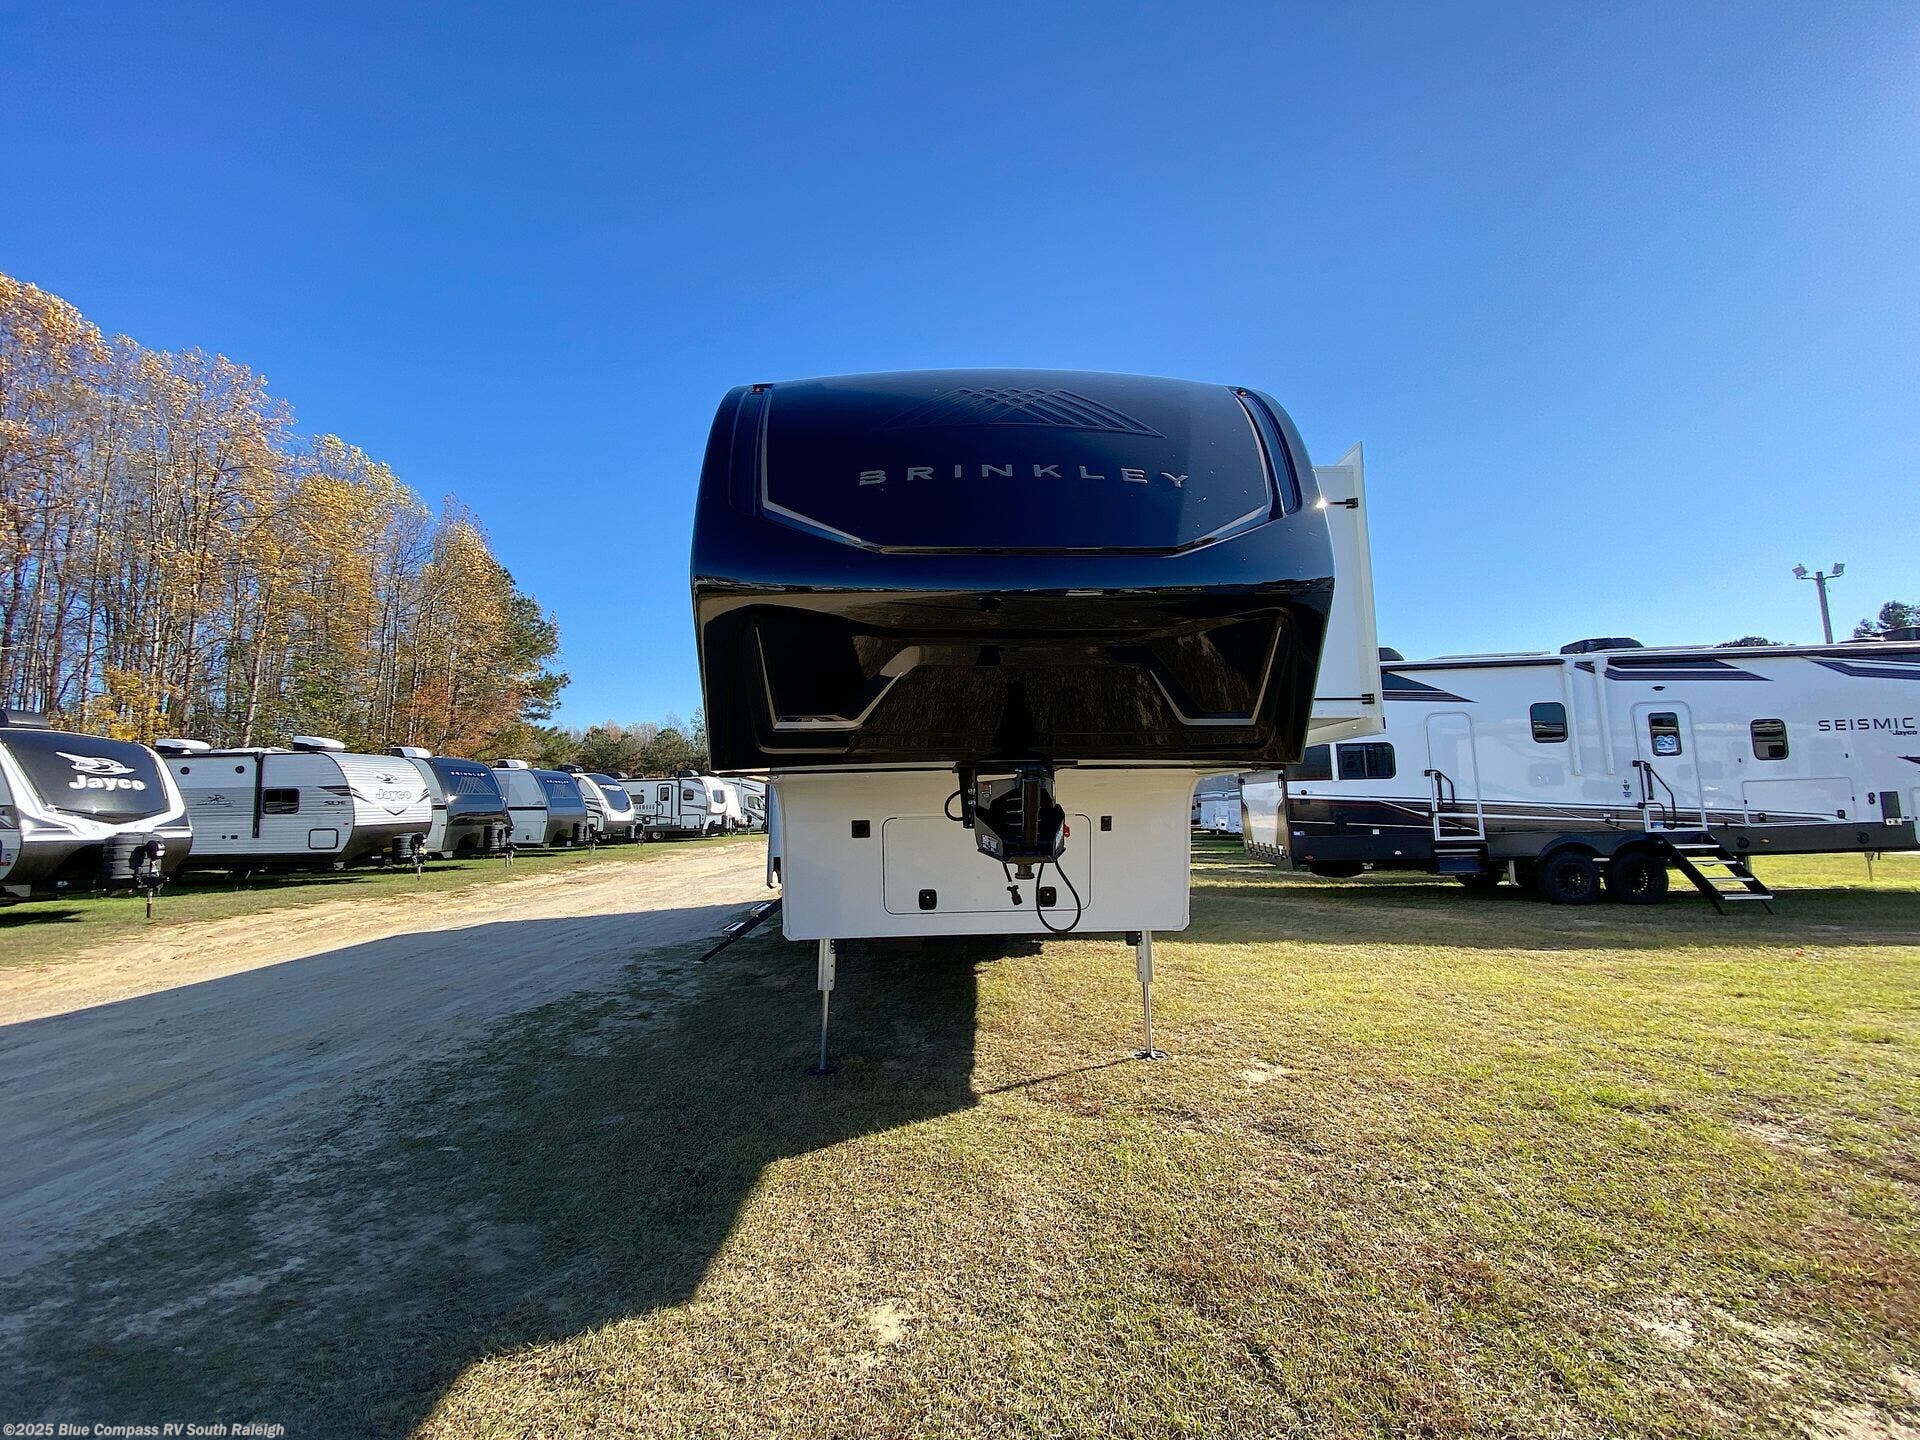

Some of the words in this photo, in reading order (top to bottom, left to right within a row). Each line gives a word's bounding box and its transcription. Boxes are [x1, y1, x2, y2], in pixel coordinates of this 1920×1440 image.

[858, 463, 1189, 488] BRINKLEY
[1817, 717, 1916, 732] SEISMIC
[68, 774, 146, 791] Jayco
[376, 788, 412, 801] Jayco
